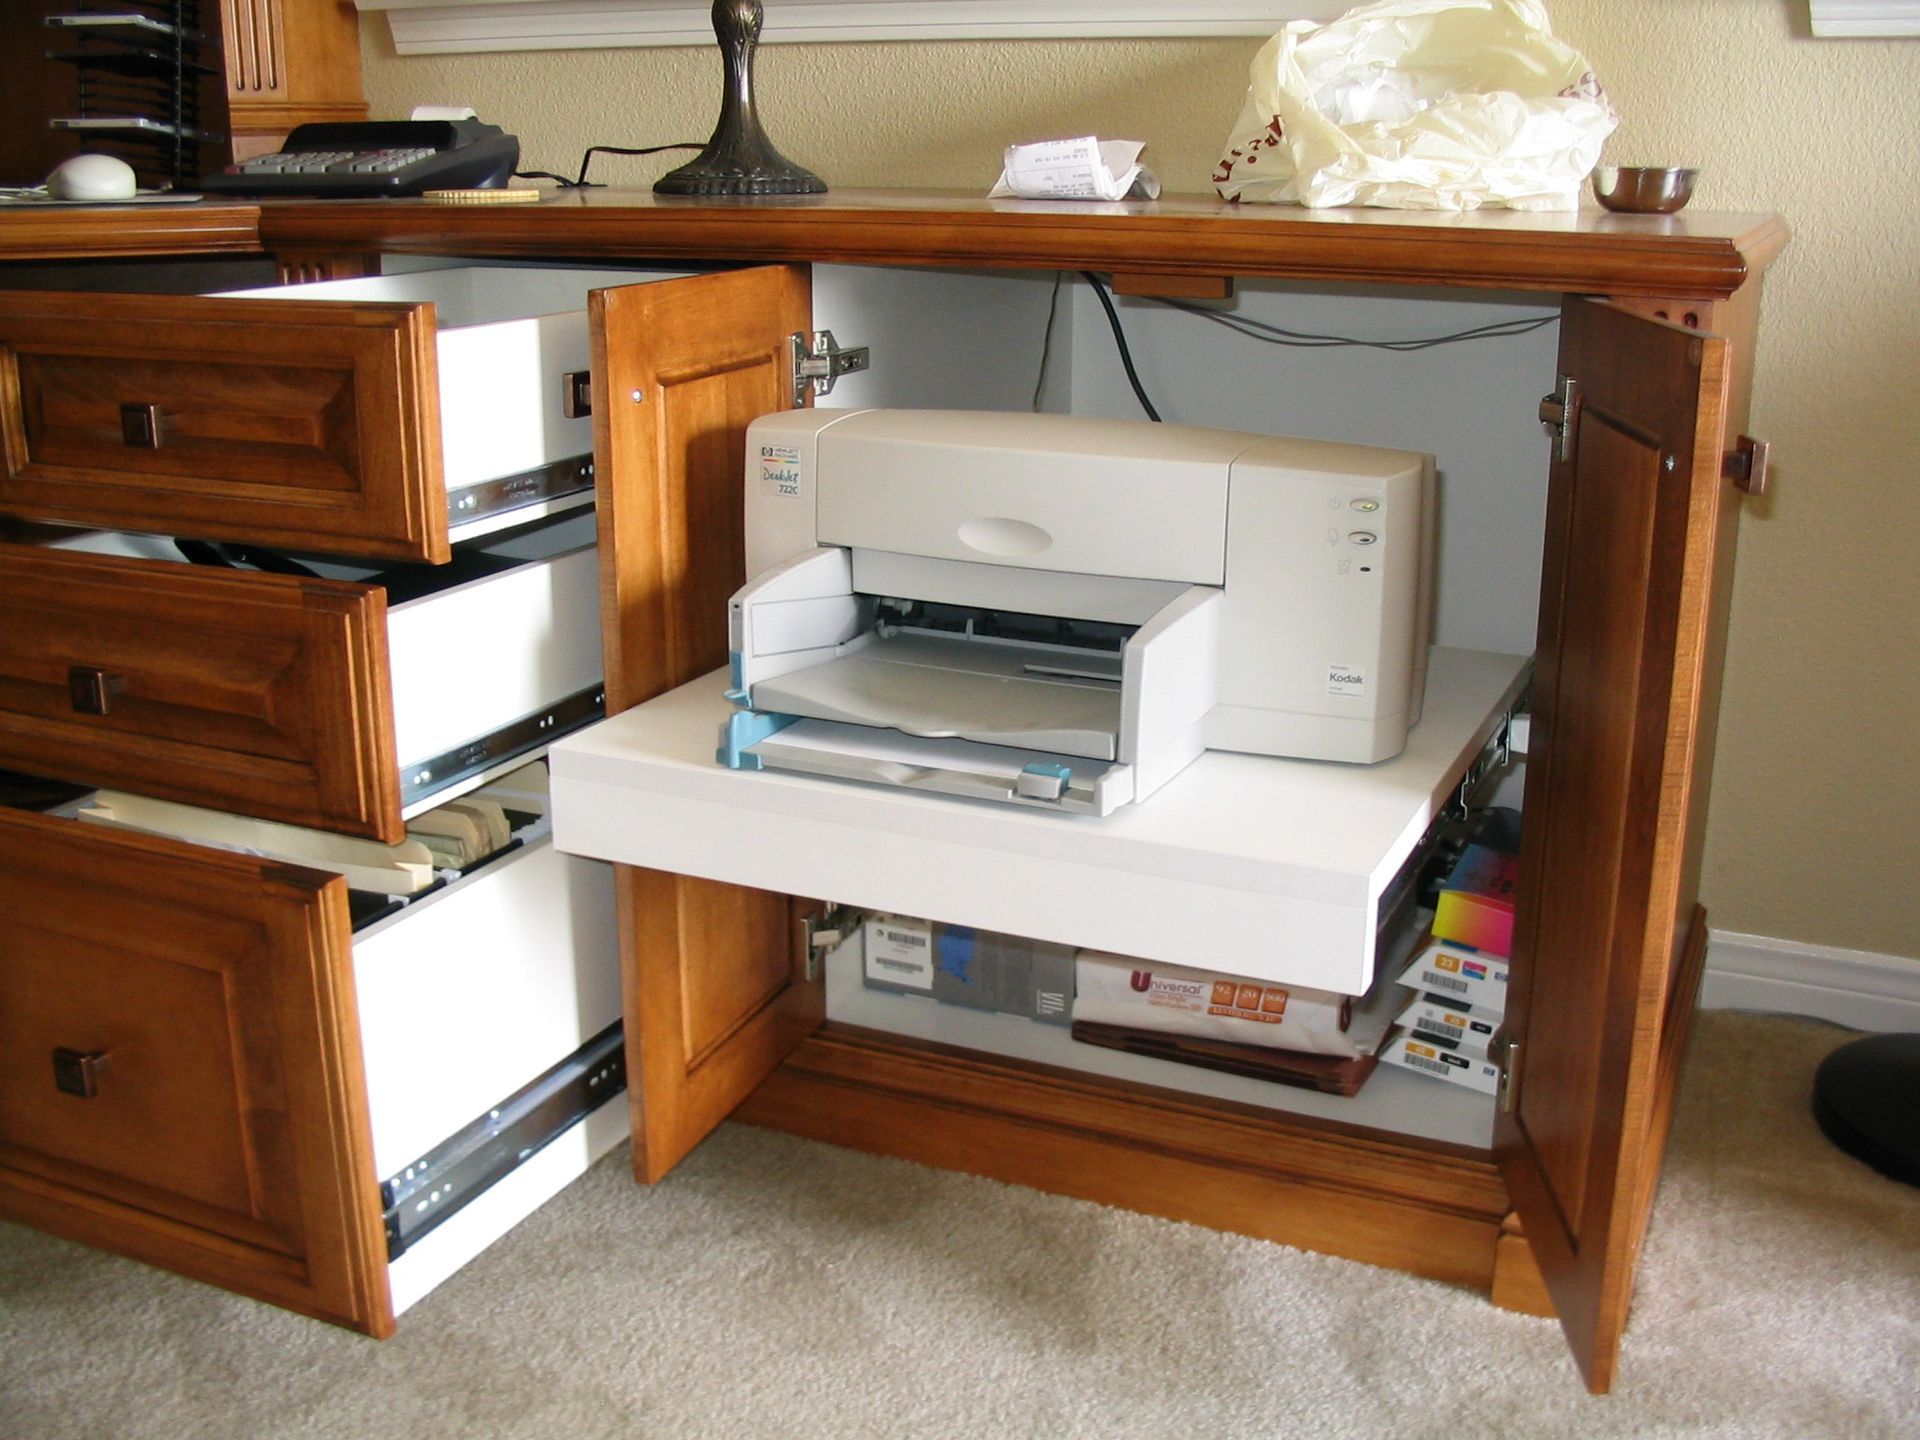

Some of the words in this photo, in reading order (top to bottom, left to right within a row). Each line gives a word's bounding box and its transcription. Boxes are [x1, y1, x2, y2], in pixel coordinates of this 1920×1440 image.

[779, 485, 799, 495] 722C
[1329, 673, 1363, 684] Kodak
[1131, 969, 1201, 995] Universal
